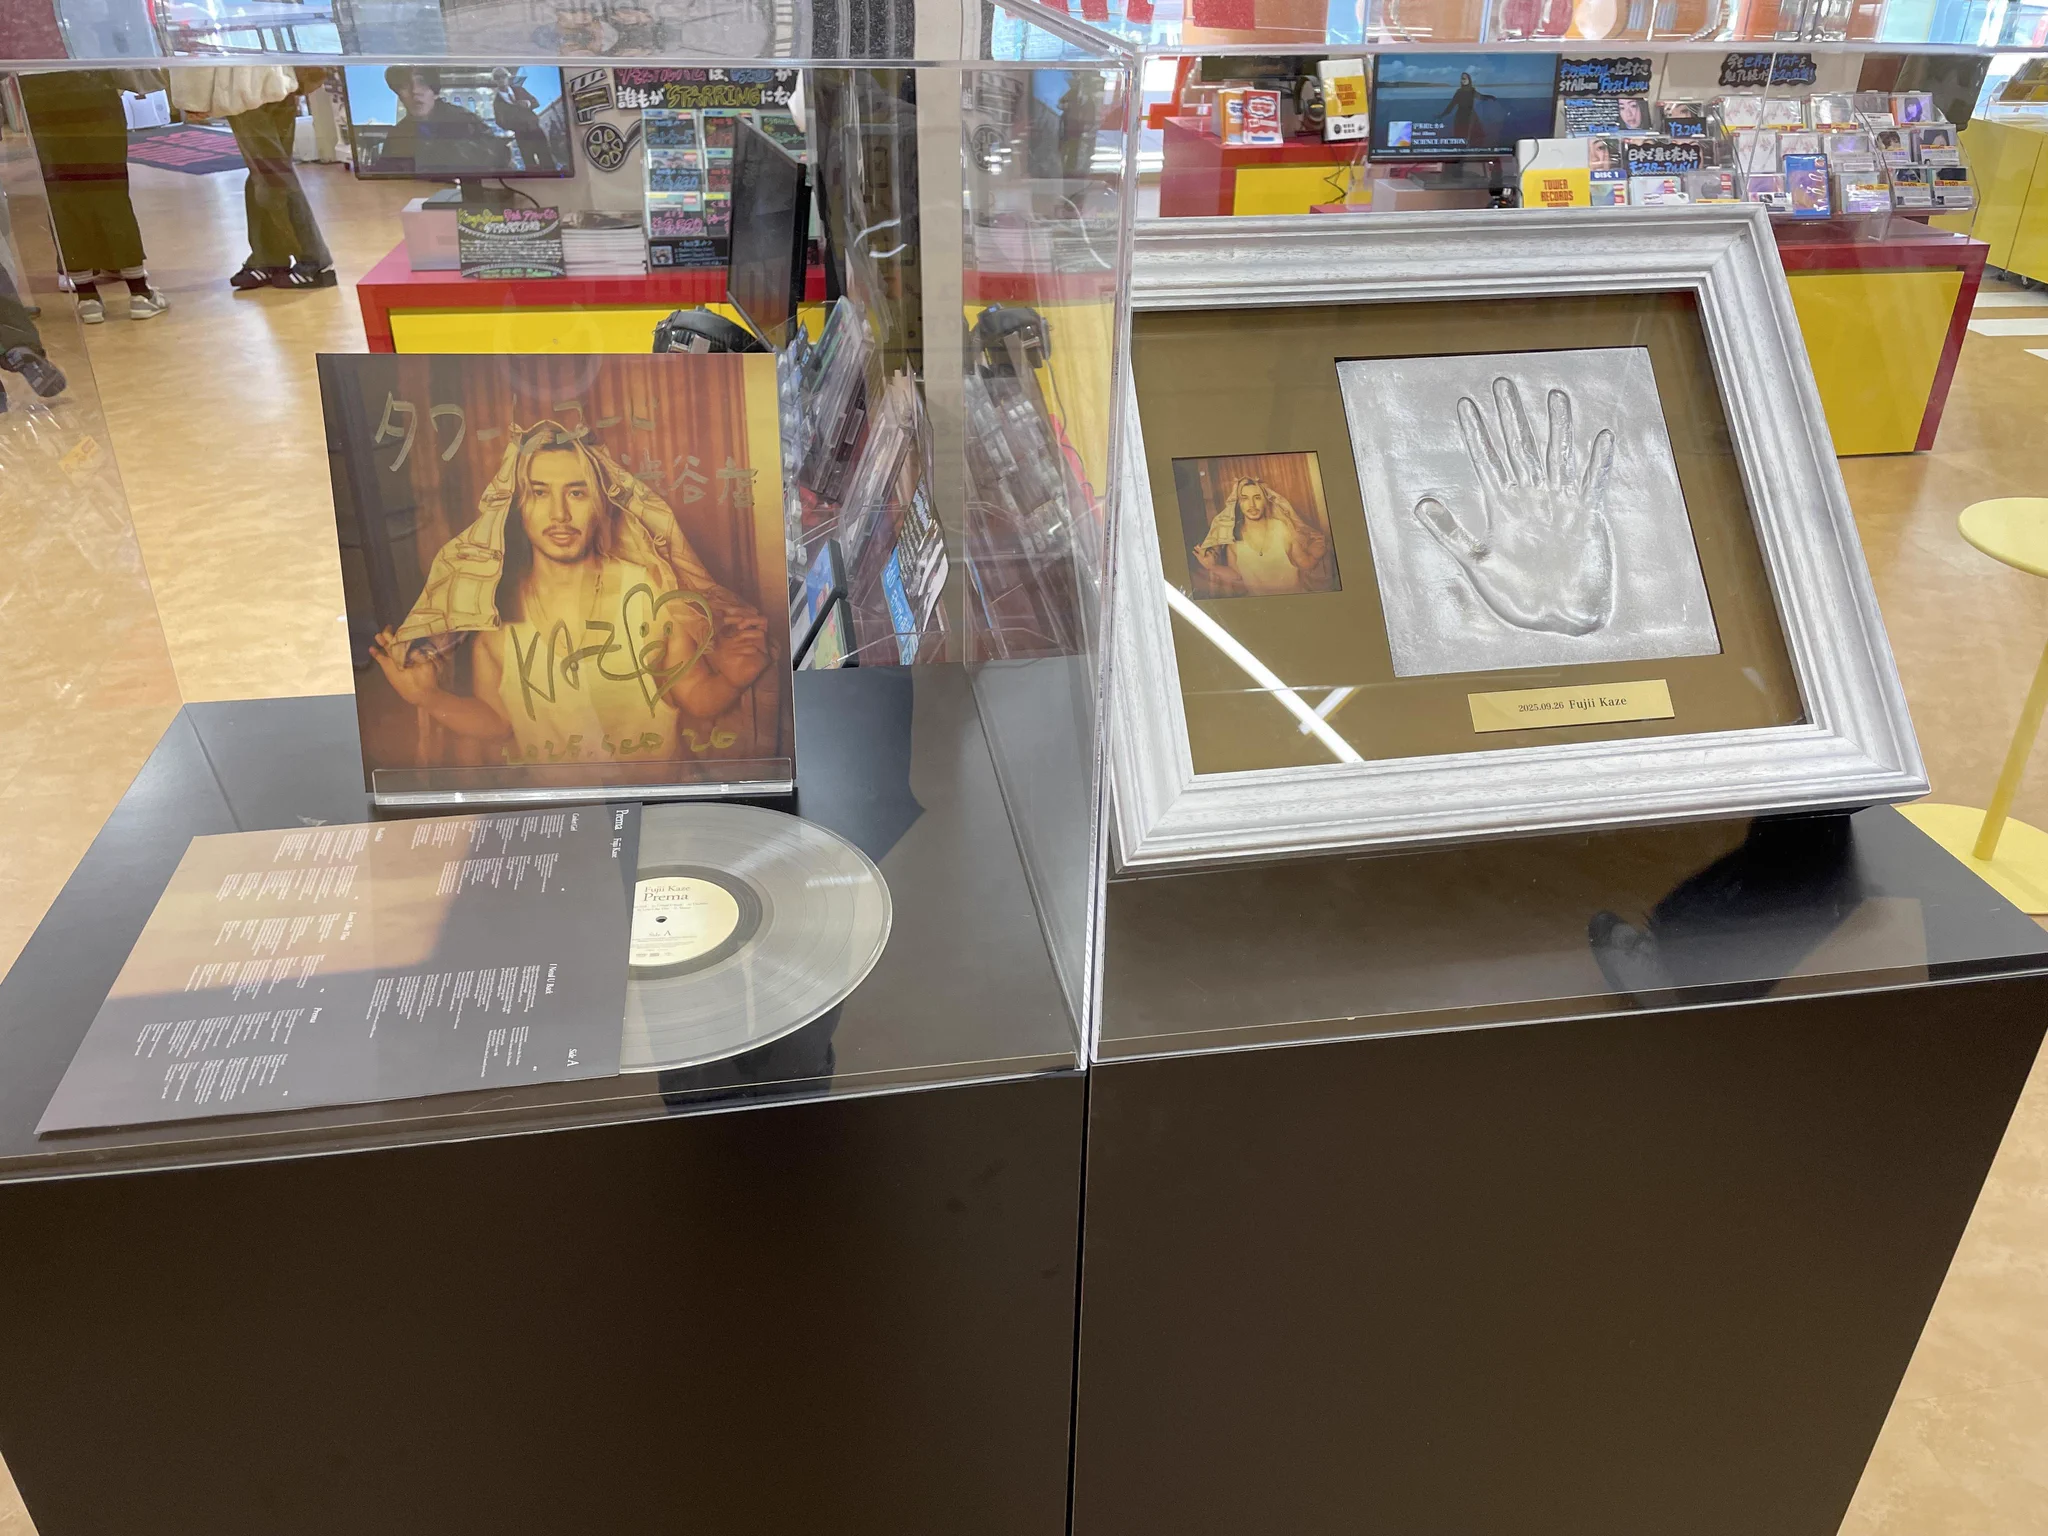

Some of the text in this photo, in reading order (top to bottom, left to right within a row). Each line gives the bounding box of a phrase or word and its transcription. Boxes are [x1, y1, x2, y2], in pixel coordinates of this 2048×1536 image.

[1628, 147, 1698, 162] 日本で最も売れた
[1543, 179, 1569, 190] TOWER
[1540, 190, 1574, 202] RECORDS
[374, 391, 659, 471] タワーレコード
[621, 448, 758, 508] 渋谷店
[1518, 697, 1628, 712] 2025.09.26 Fujii Kaze
[644, 886, 665, 894] Fujii
[643, 893, 689, 901] Prema
